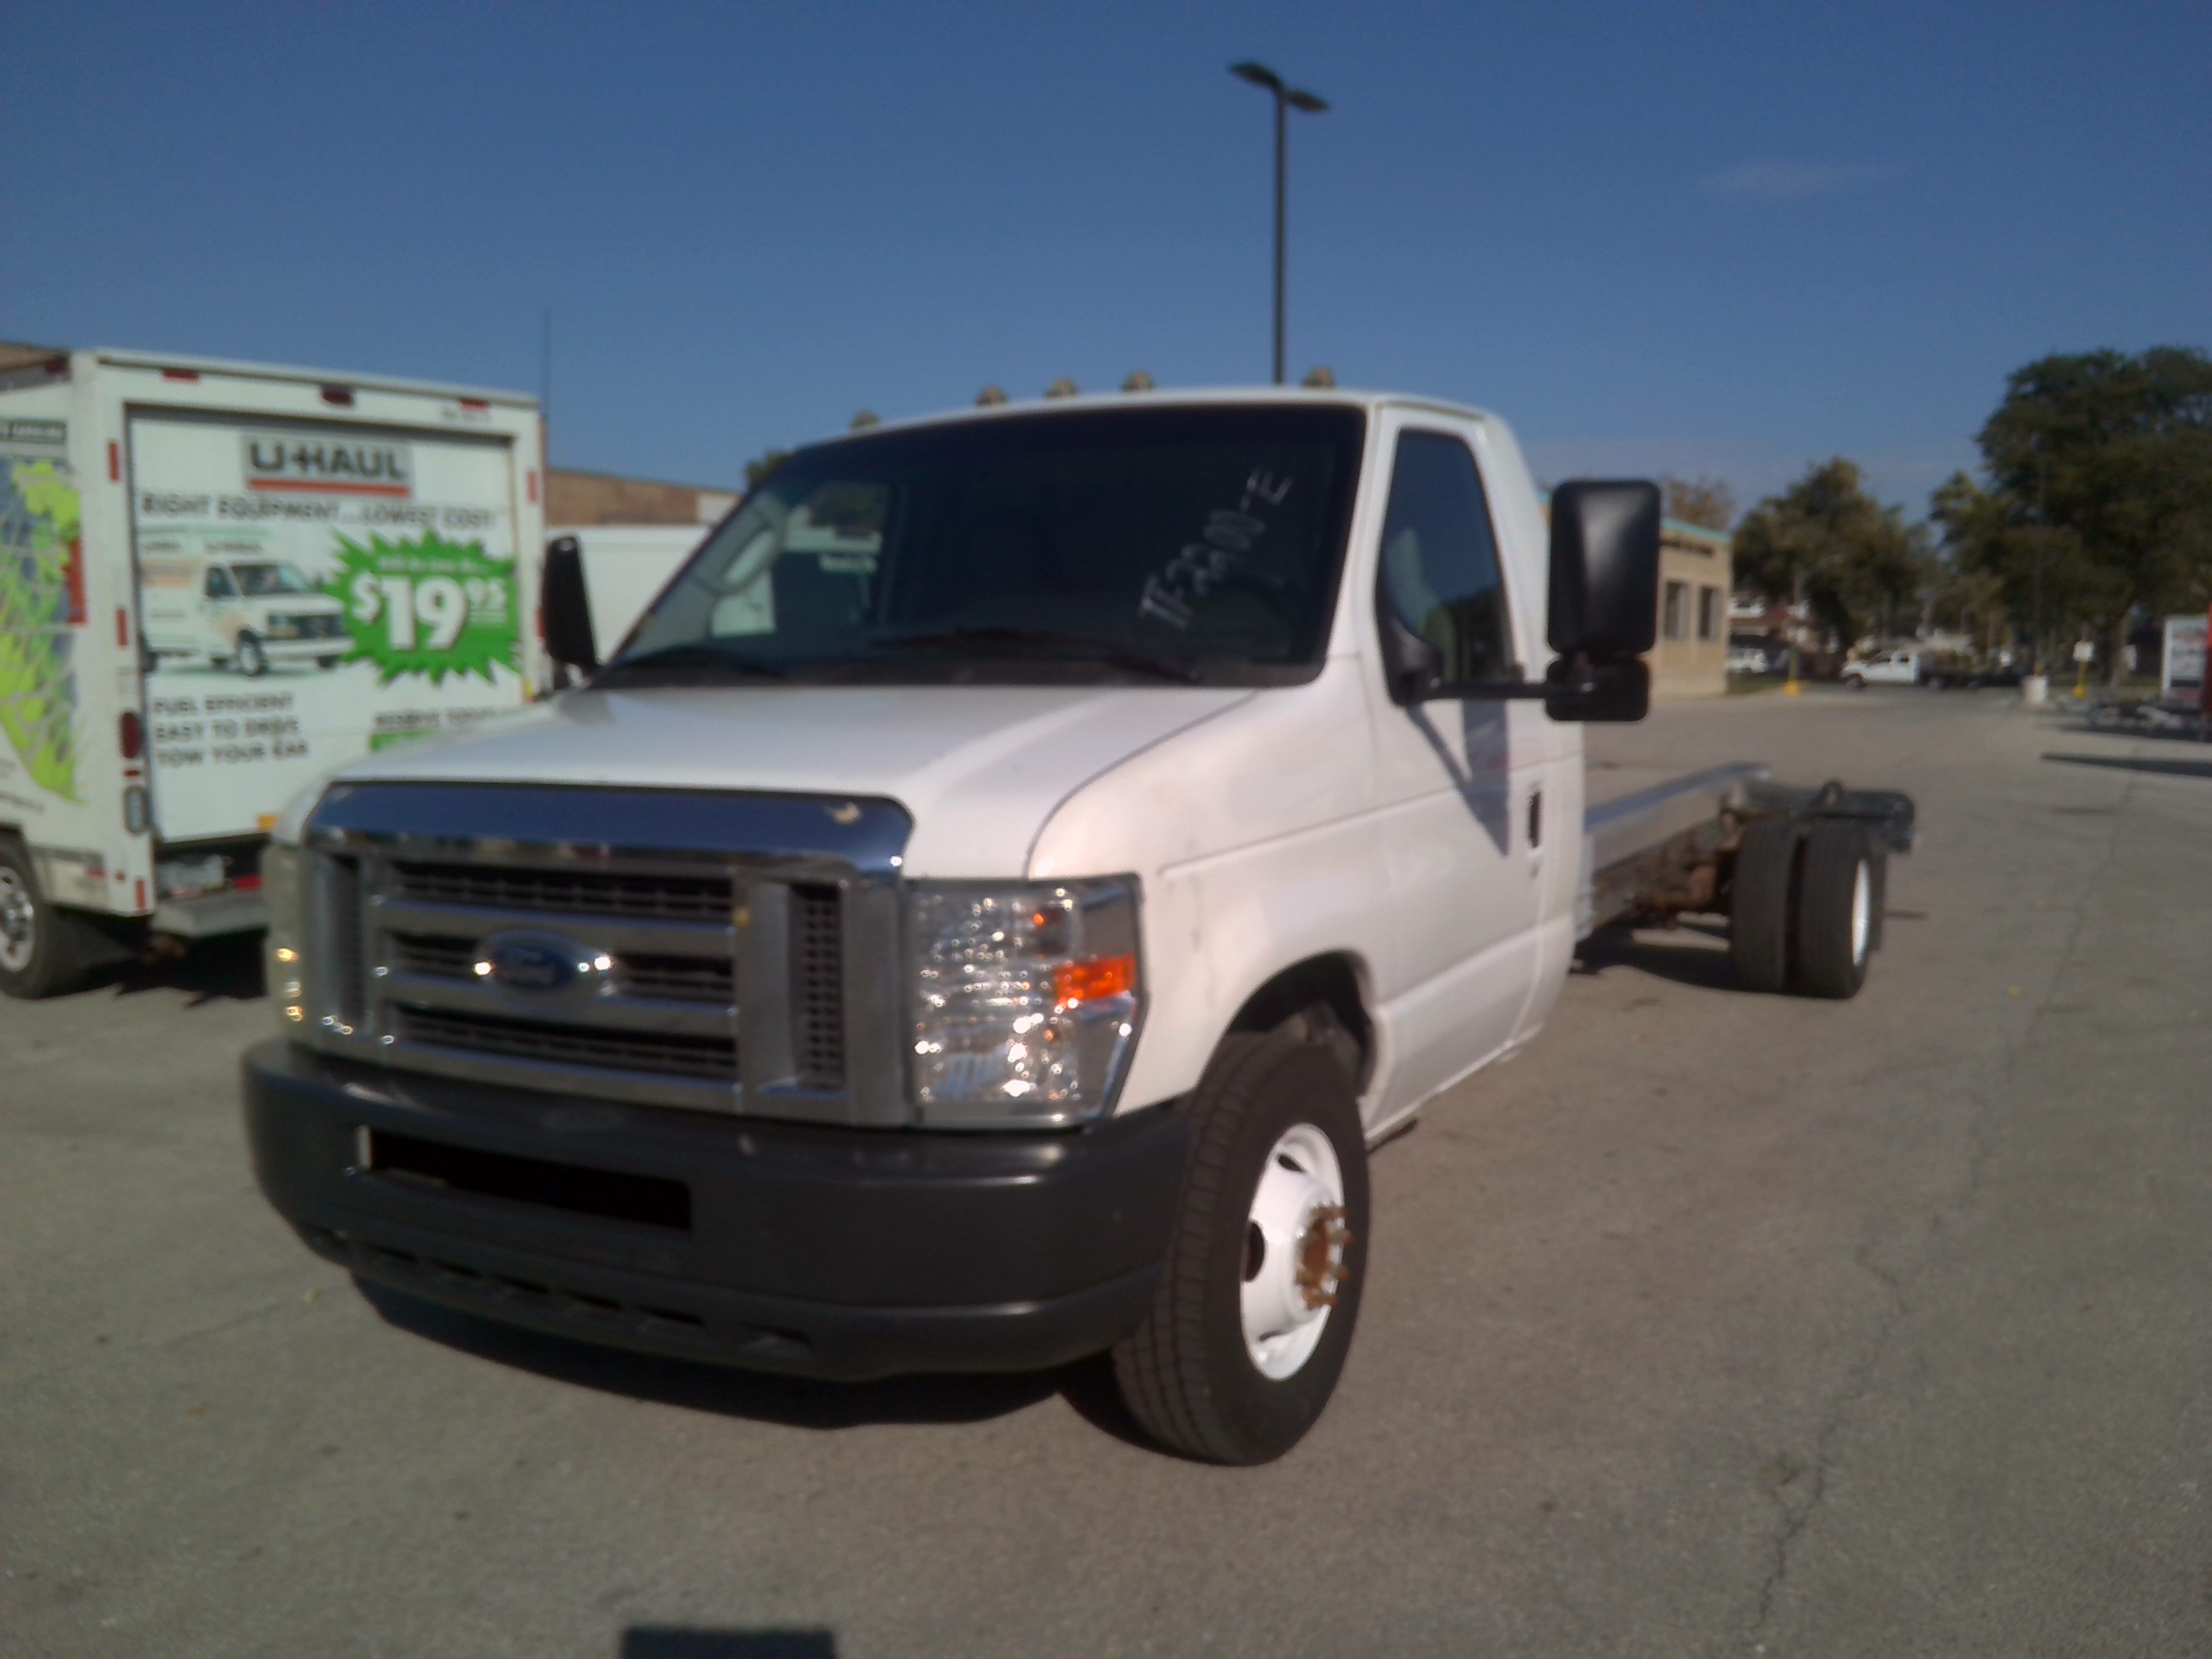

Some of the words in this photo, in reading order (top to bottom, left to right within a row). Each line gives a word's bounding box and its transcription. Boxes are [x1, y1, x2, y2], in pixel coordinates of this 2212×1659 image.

[141, 493, 209, 516] RIGHT
[154, 697, 197, 716] FUEL
[205, 691, 293, 714] EFFICIENT
[155, 722, 203, 743] EASY
[212, 719, 238, 739] TO
[155, 747, 203, 767] TOW
[212, 744, 266, 764] YOUR
[272, 740, 308, 760] CAR
